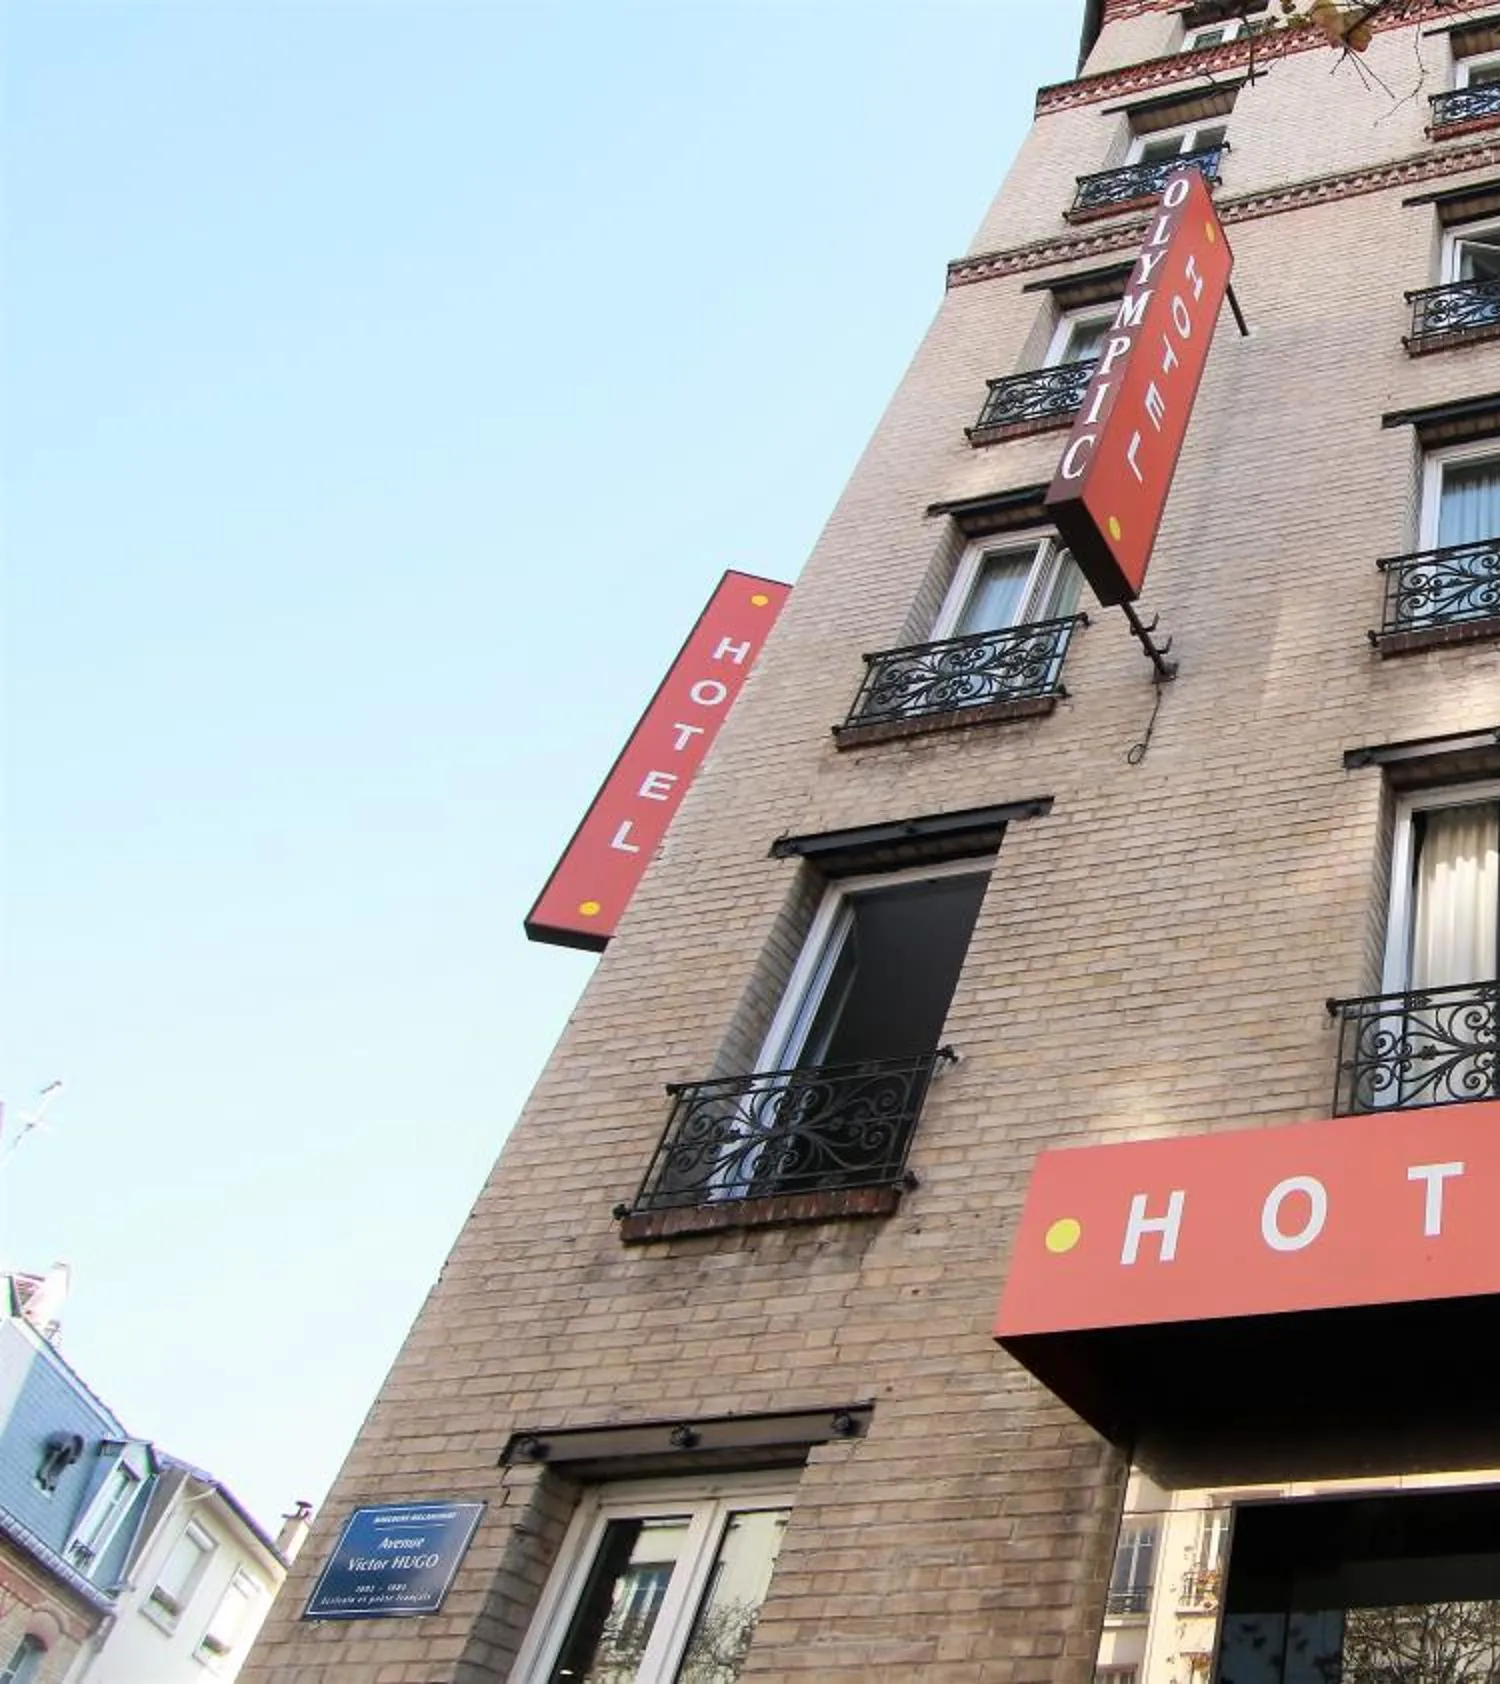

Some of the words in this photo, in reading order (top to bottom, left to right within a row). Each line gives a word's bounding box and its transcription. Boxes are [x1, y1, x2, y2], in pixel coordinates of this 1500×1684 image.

[1061, 178, 1189, 479] OLYMPIC
[1127, 255, 1203, 482] HOTEL
[611, 637, 751, 853] HOTEL
[348, 1557, 389, 1571] Victor
[391, 1553, 439, 1569] HUGO
[380, 1537, 425, 1549] Avenue
